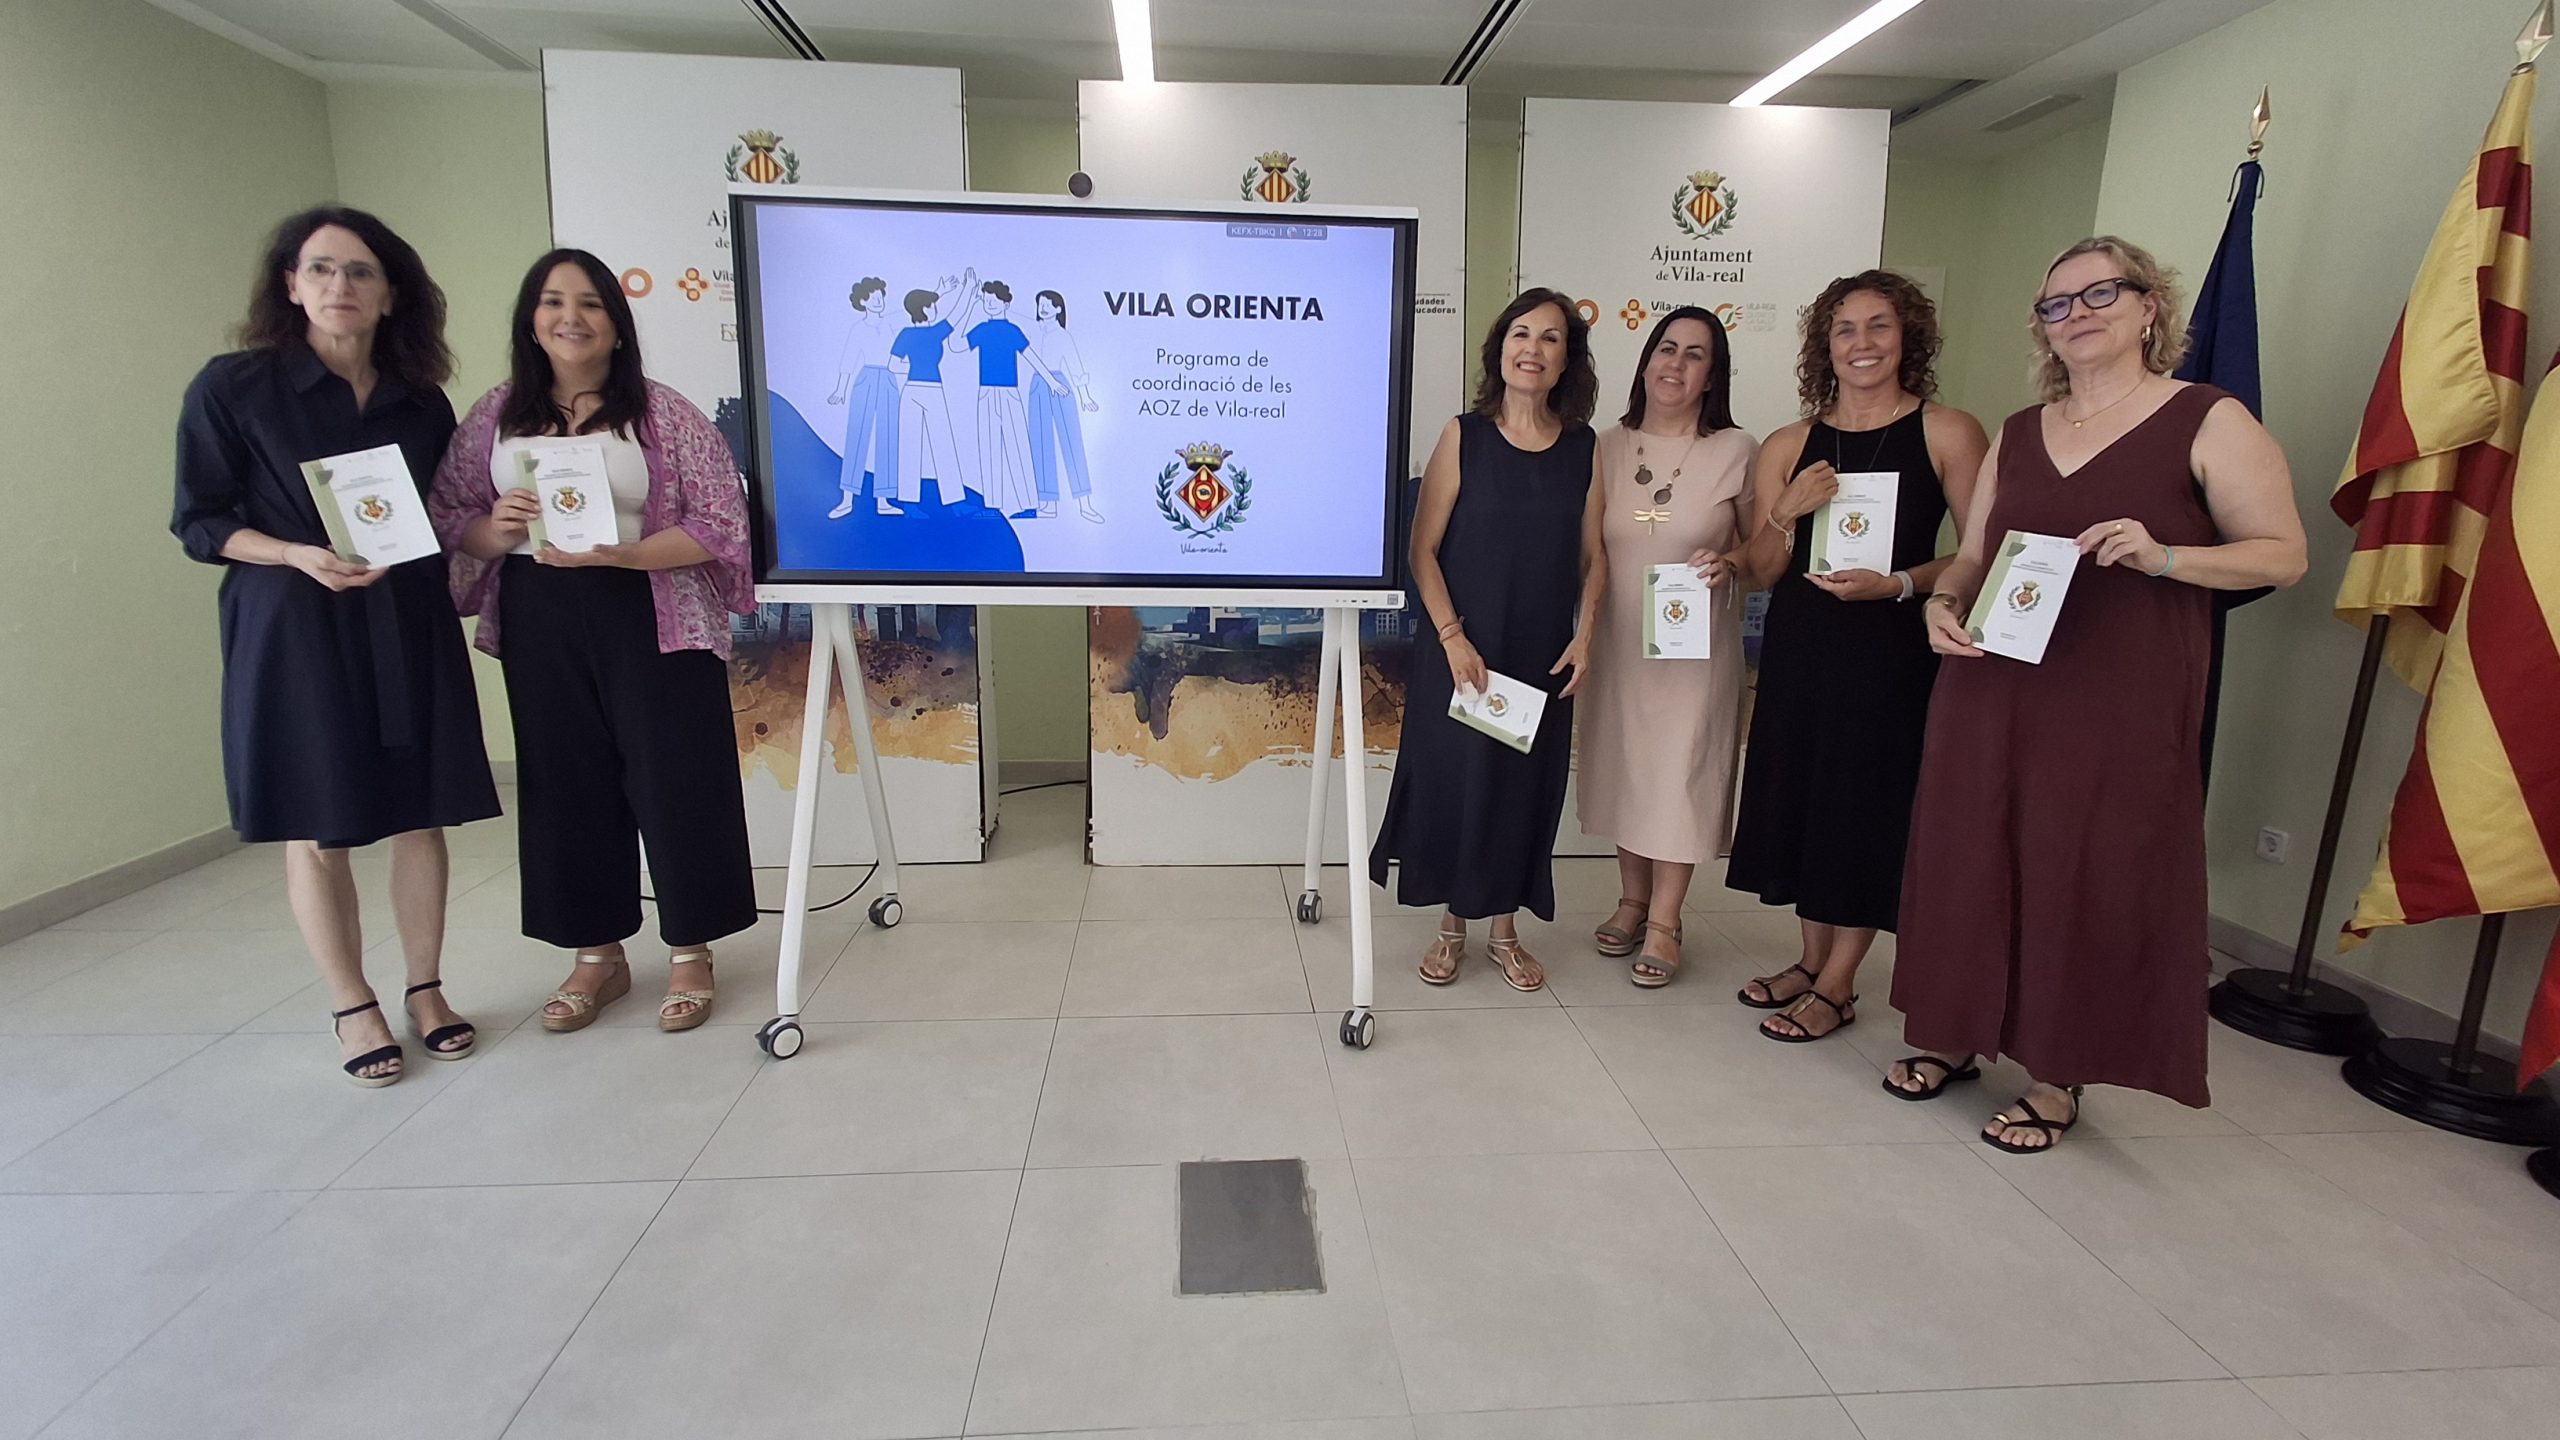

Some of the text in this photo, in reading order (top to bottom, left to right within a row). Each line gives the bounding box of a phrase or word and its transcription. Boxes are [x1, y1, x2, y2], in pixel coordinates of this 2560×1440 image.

[1650, 245, 1753, 265] Ajuntament
[1656, 266, 1744, 283] de Vila-real
[1104, 291, 1324, 321] VILA ORIENTA
[1156, 348, 1269, 370] Programa de
[1132, 373, 1292, 394] coordinació de les
[1138, 399, 1286, 419] AOZ de Vila-real
